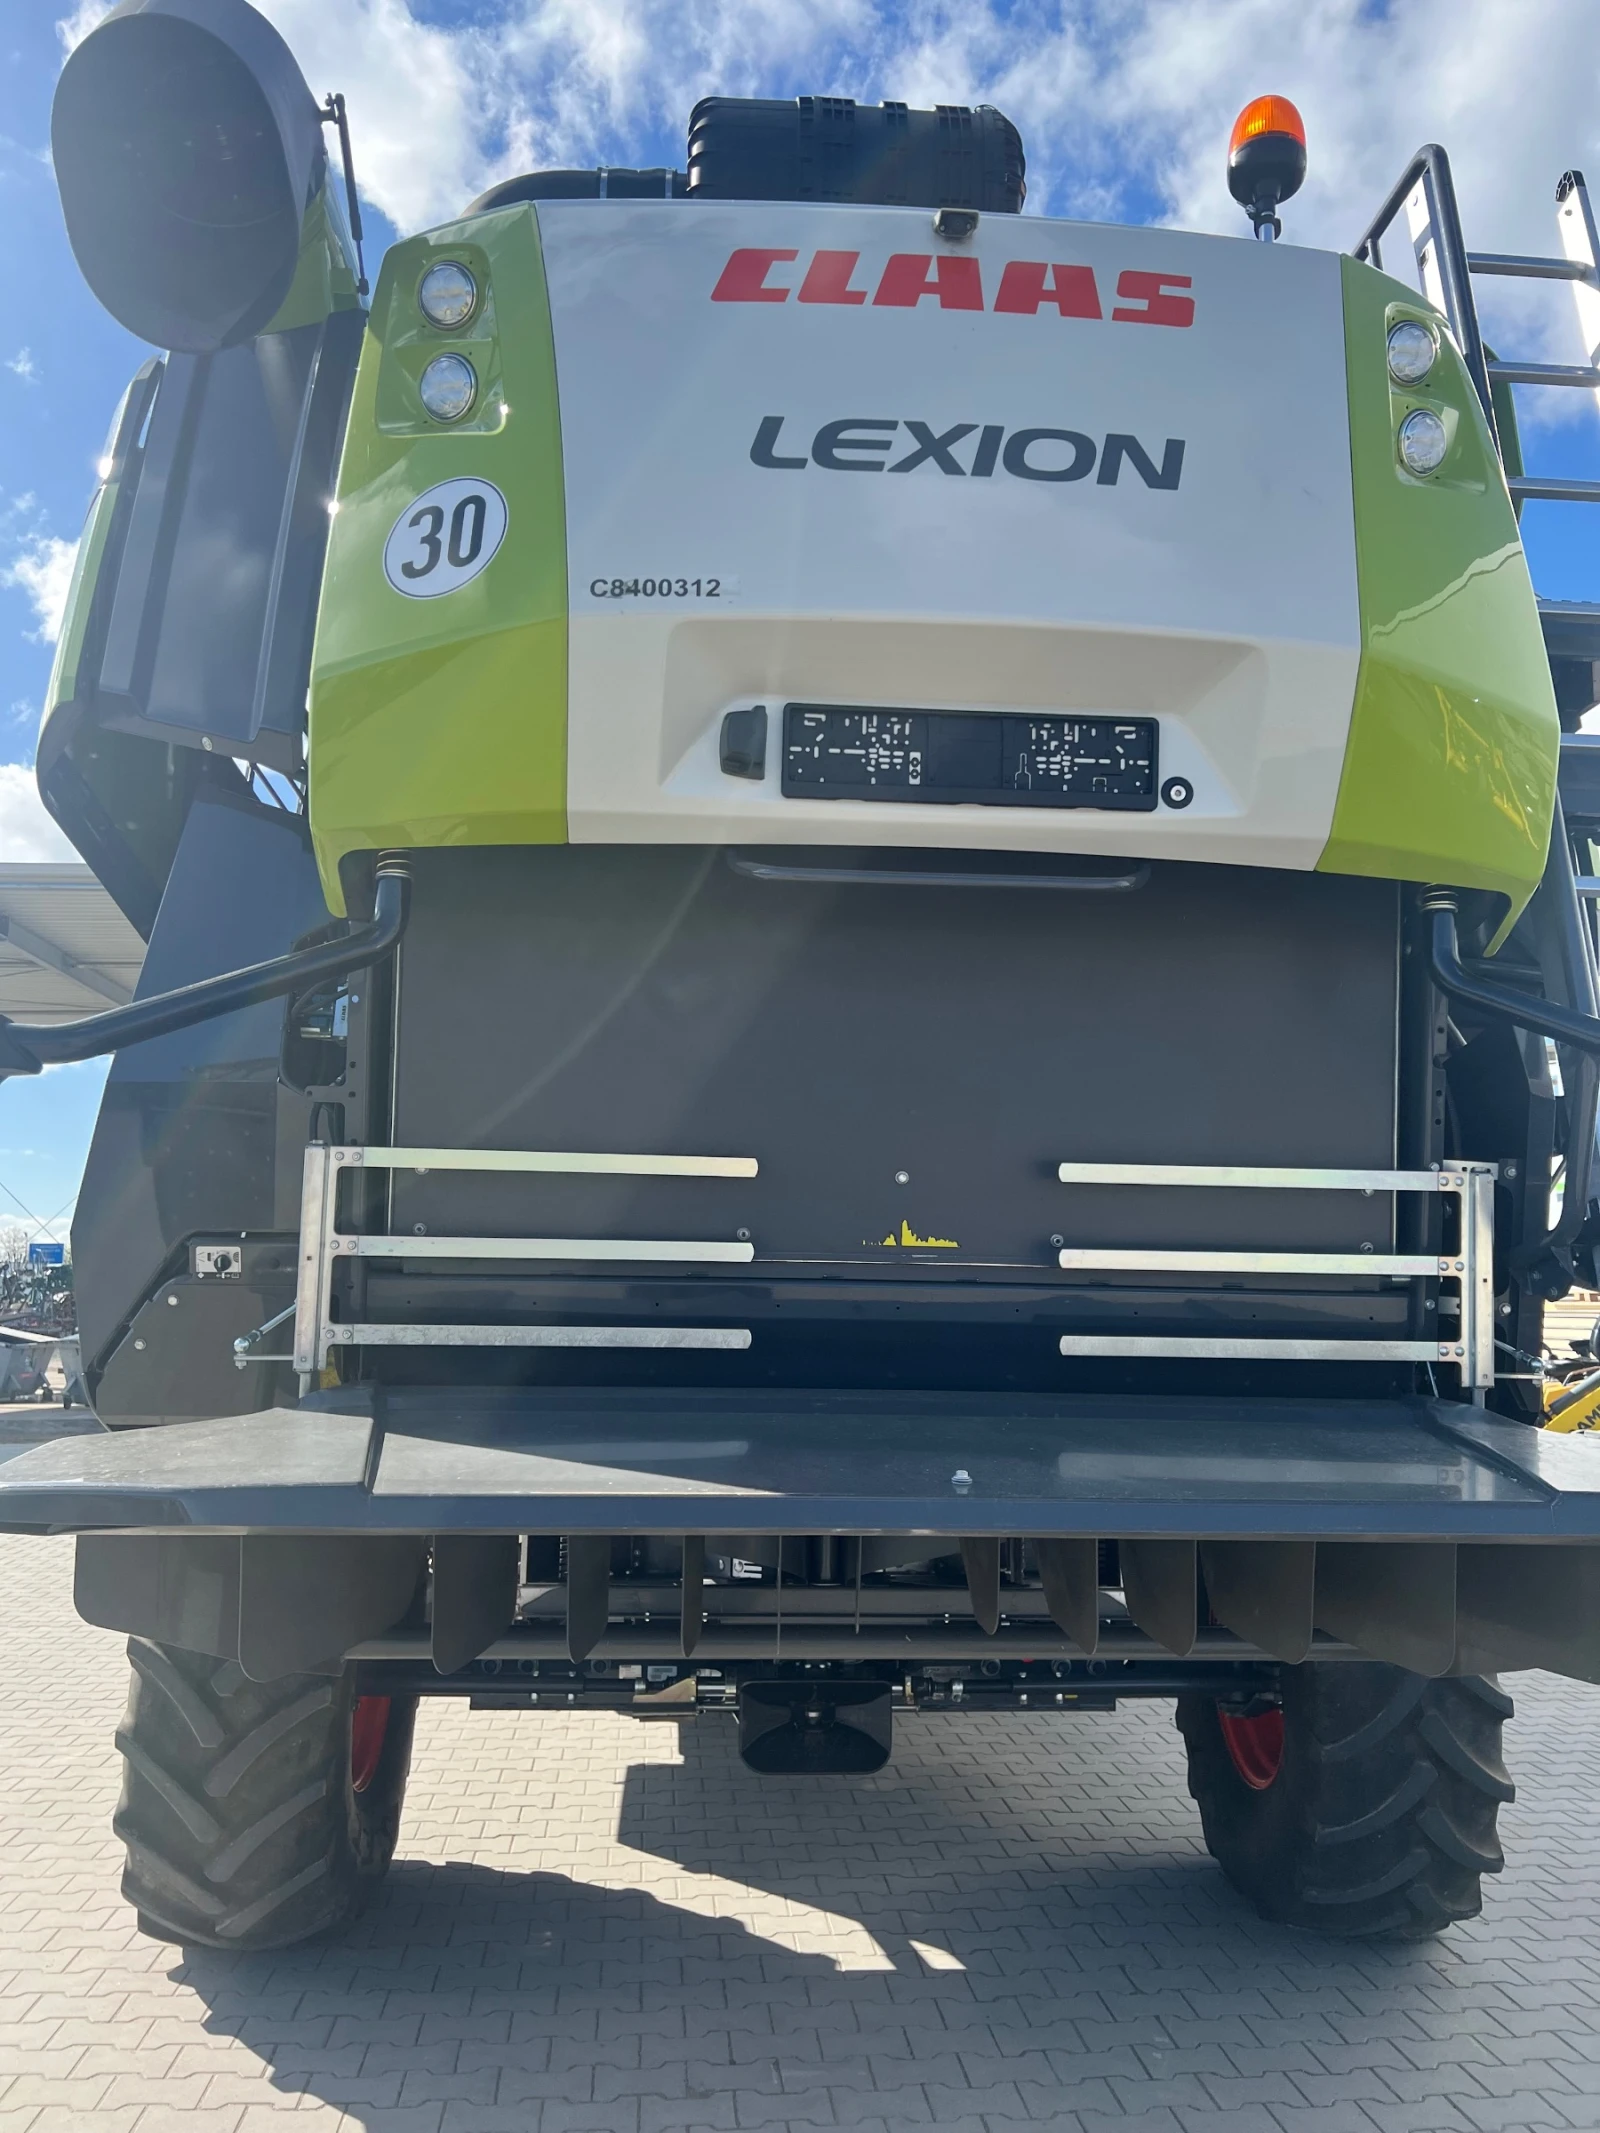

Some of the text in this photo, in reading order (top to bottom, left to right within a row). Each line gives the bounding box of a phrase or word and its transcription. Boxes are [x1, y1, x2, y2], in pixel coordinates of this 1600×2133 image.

[711, 248, 1194, 327] CLAAS
[750, 416, 1186, 491] LEXION
[402, 494, 487, 579] 30
[590, 578, 721, 598] C8400312
